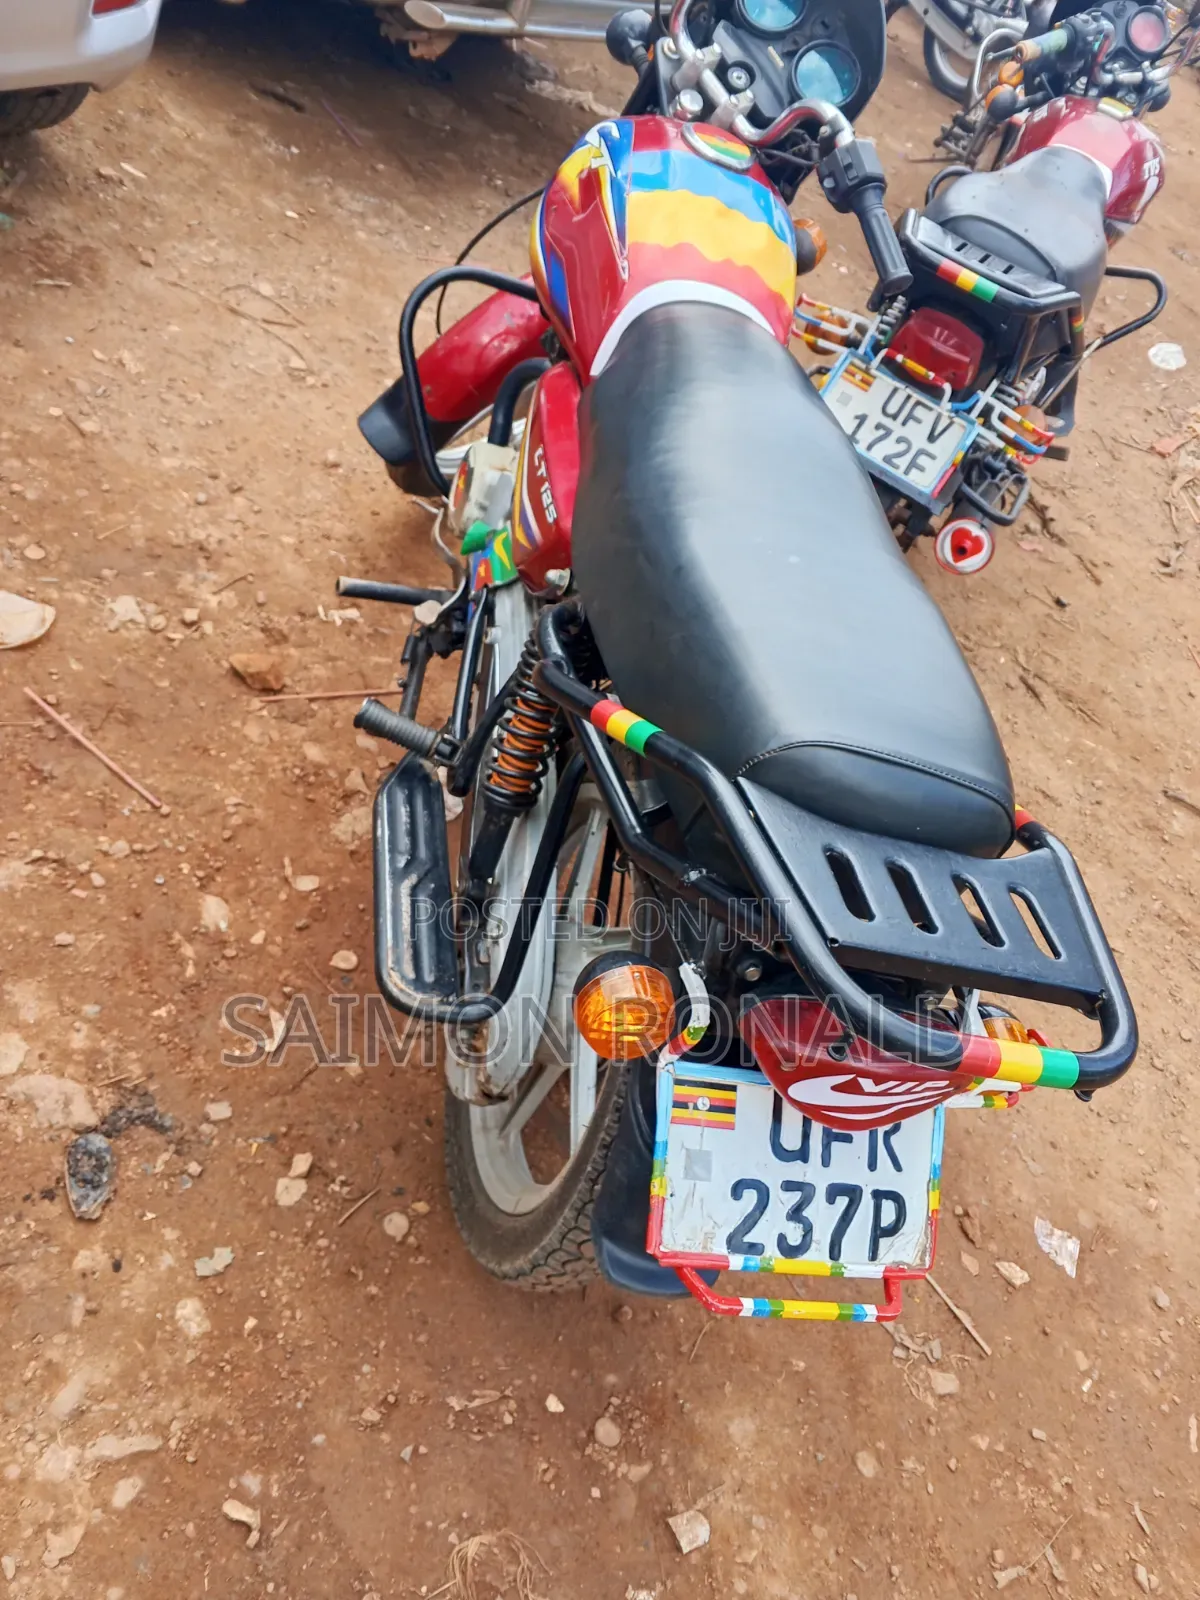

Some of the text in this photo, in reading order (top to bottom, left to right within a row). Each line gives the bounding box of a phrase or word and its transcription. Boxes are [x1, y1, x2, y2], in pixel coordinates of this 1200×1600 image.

[852, 413, 938, 476] 172F
[881, 386, 955, 444] UFV
[855, 1076, 950, 1094] VIP
[725, 1177, 907, 1262] 237P
